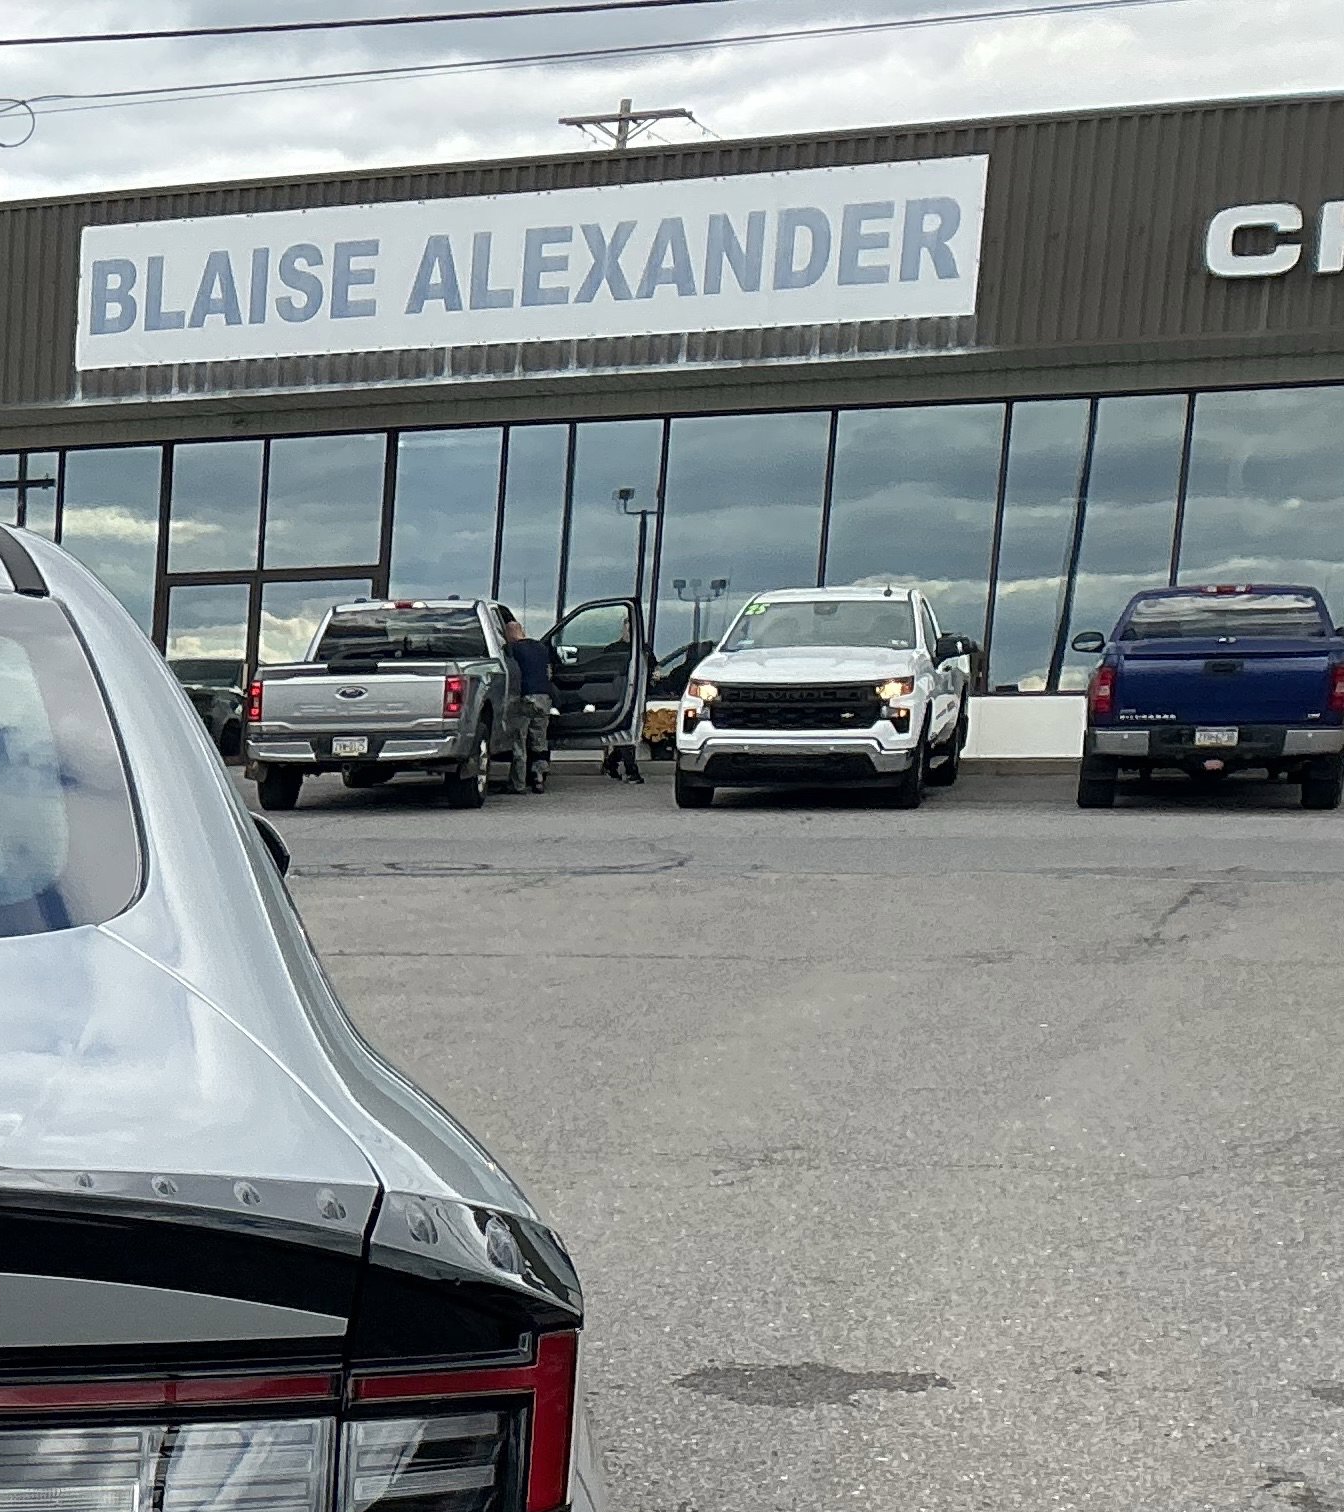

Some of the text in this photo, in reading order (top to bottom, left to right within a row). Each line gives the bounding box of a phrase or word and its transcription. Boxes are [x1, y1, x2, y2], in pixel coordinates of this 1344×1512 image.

[89, 196, 963, 335] BLAISE ALEXANDER
[1204, 199, 1344, 277] C
